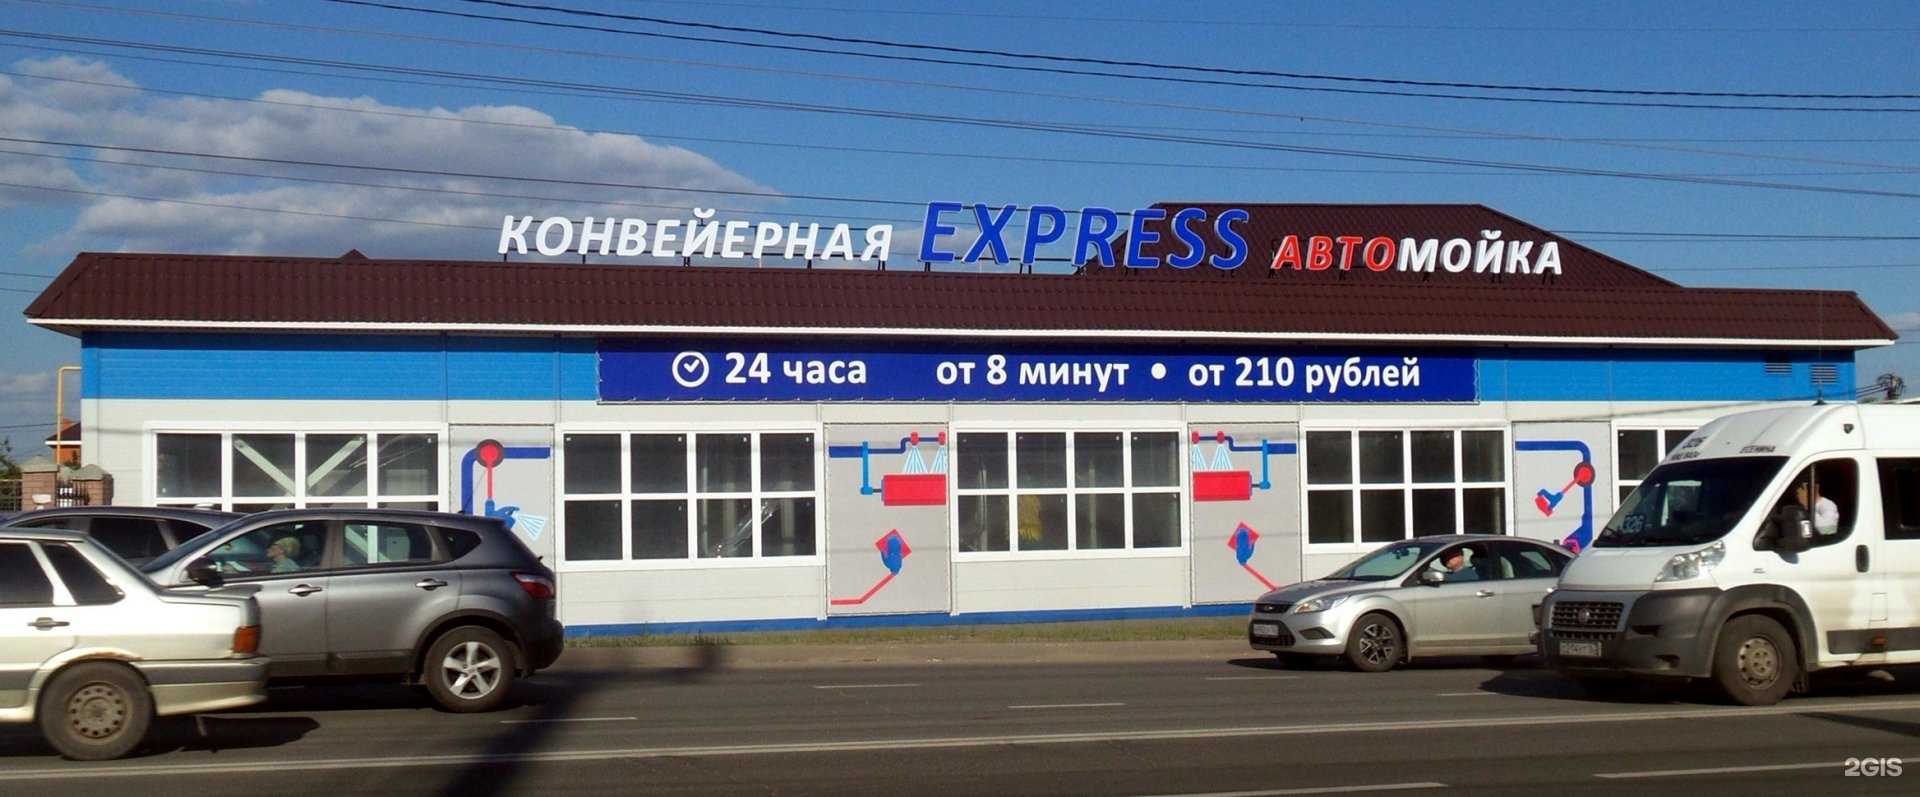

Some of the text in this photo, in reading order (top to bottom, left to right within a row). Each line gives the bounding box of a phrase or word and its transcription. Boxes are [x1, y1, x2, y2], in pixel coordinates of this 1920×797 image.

[498, 208, 893, 262] КОНВЕЙЕРНАЯ
[918, 200, 1250, 270] EXPRESS
[1271, 230, 1562, 275] АВТОМОЙКА
[725, 352, 1420, 393] 24 часа от 8 минут от 210 рублей
